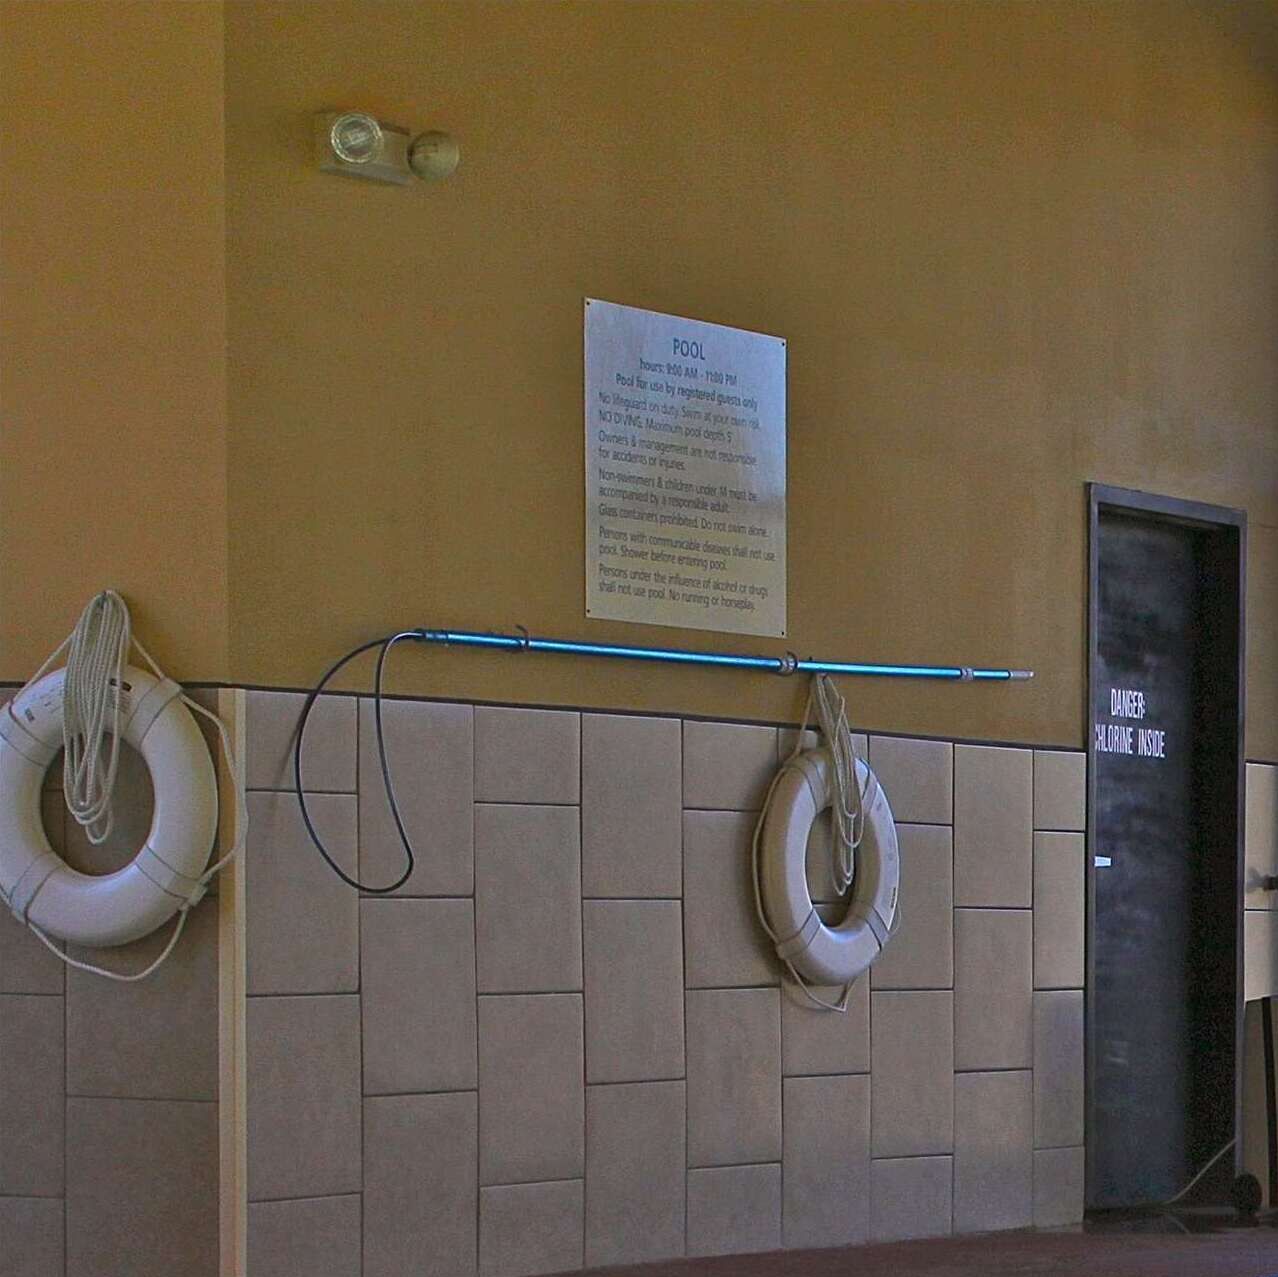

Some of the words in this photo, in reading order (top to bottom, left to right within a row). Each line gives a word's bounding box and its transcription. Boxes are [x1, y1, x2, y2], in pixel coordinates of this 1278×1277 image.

[672, 337, 705, 360] POOL
[640, 357, 663, 372] hours:
[683, 366, 697, 379] AM
[725, 374, 736, 386] PM
[616, 372, 633, 386] Pool
[636, 376, 647, 388] for
[650, 380, 663, 391] use
[665, 381, 674, 396] by
[677, 383, 715, 404] registered
[716, 390, 739, 408] guests
[742, 395, 757, 411] only
[599, 391, 610, 404] No
[612, 393, 647, 413] lifeguard
[649, 402, 659, 412] on
[712, 413, 728, 427] your
[599, 409, 611, 422] NO
[684, 424, 700, 440] pool
[703, 427, 724, 444] depth
[598, 430, 628, 445] Owners
[631, 435, 636, 446] &
[639, 437, 688, 458] management
[690, 447, 702, 457] are
[703, 447, 715, 459] not
[599, 448, 609, 459] for
[612, 450, 647, 464] accidents
[648, 458, 656, 466] or
[599, 468, 654, 486] Non-swimmers
[657, 477, 662, 487] &
[665, 478, 691, 492] children
[695, 483, 716, 495] under
[599, 485, 648, 505] accompanied
[650, 493, 659, 507] by
[668, 495, 708, 514] responsible
[599, 503, 617, 517] Glass
[619, 506, 657, 522] containers
[701, 518, 711, 530] Do
[713, 519, 725, 532] not
[727, 522, 746, 534] swim
[599, 526, 627, 541] Persons
[630, 531, 647, 543] with
[649, 533, 699, 550] communicable
[703, 540, 730, 554] diseases
[732, 544, 747, 556] shall
[750, 547, 761, 558] not
[763, 551, 775, 560] use
[620, 545, 648, 560] Shower
[650, 549, 675, 563] before
[678, 553, 707, 570] entering
[599, 564, 627, 578] Persons
[630, 567, 650, 581] under
[654, 570, 665, 583] the
[668, 572, 701, 587] influence
[703, 576, 710, 588] of
[712, 578, 737, 591] alcohol
[739, 583, 745, 592] or
[748, 582, 767, 598] drugs
[599, 581, 615, 593] shall
[618, 583, 630, 595] not
[632, 587, 644, 597] use
[669, 589, 679, 600] No
[682, 590, 709, 607] running
[711, 596, 718, 605] or
[1137, 728, 1166, 758] INSIDE
